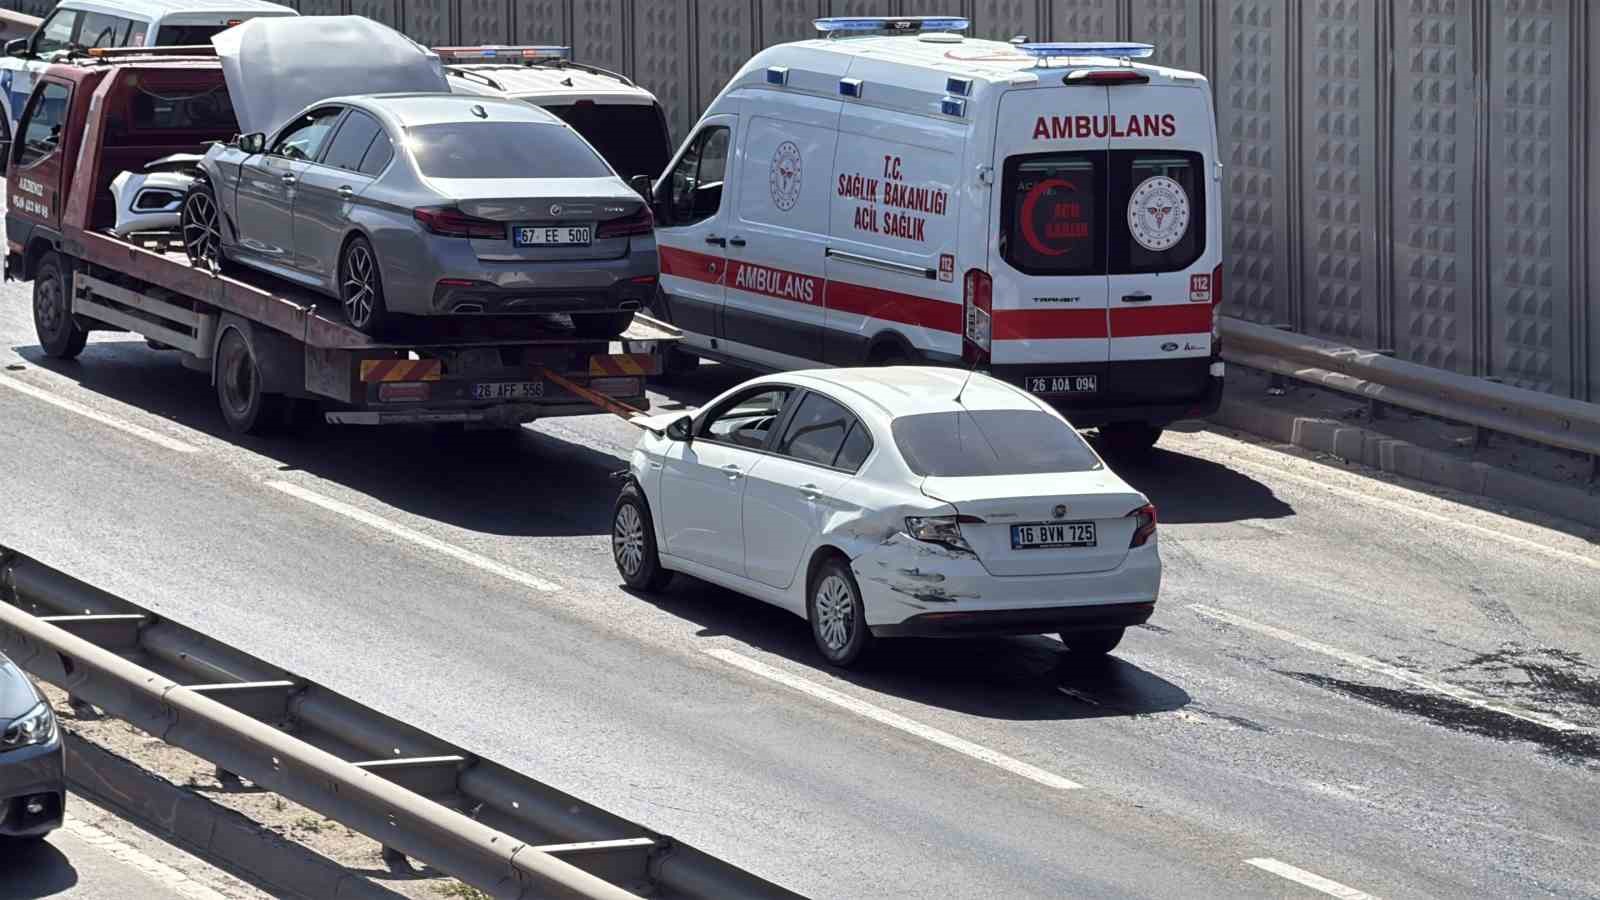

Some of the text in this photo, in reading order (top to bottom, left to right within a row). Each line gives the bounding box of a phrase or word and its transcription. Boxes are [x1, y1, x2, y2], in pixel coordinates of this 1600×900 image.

[1033, 114, 1176, 139] AMBULANS
[884, 155, 902, 180] T.C.
[838, 173, 947, 216] SAĞLIK BAKANLIĞI
[854, 206, 925, 241] ACİL SAĞLIK
[522, 229, 589, 242] 67 EE 500
[941, 256, 953, 271] 112
[735, 264, 814, 302] AMBULANS
[1193, 276, 1208, 291] 112
[479, 383, 541, 398] 26 AFF 556
[1032, 377, 1094, 392] 26 AOA 094
[1020, 525, 1093, 543] 16 BVN 725
